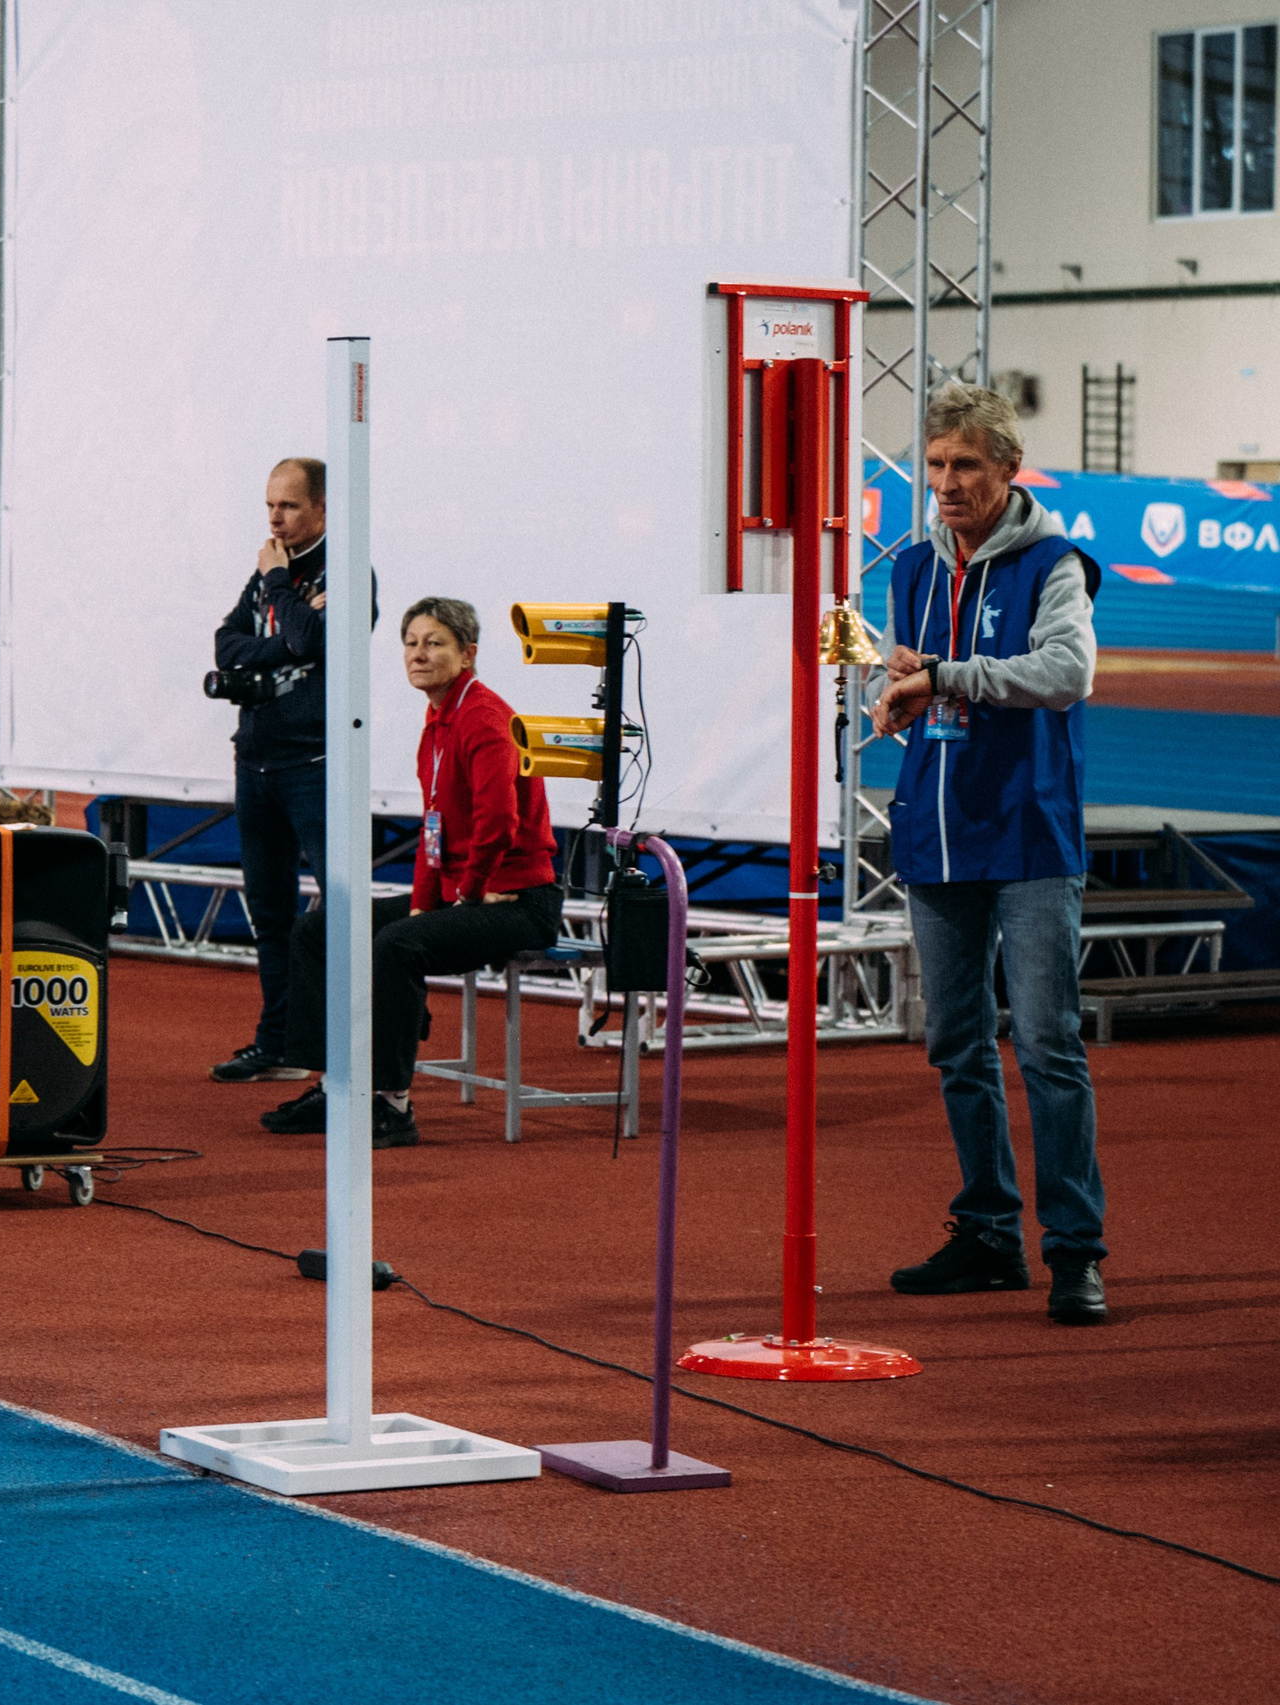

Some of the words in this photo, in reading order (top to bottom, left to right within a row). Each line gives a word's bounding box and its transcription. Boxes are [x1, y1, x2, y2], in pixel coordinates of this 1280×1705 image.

[772, 321, 814, 338] polanik
[18, 964, 56, 972] EUROLIVE
[11, 976, 89, 1007] 1000
[50, 1007, 89, 1017] WATTS
